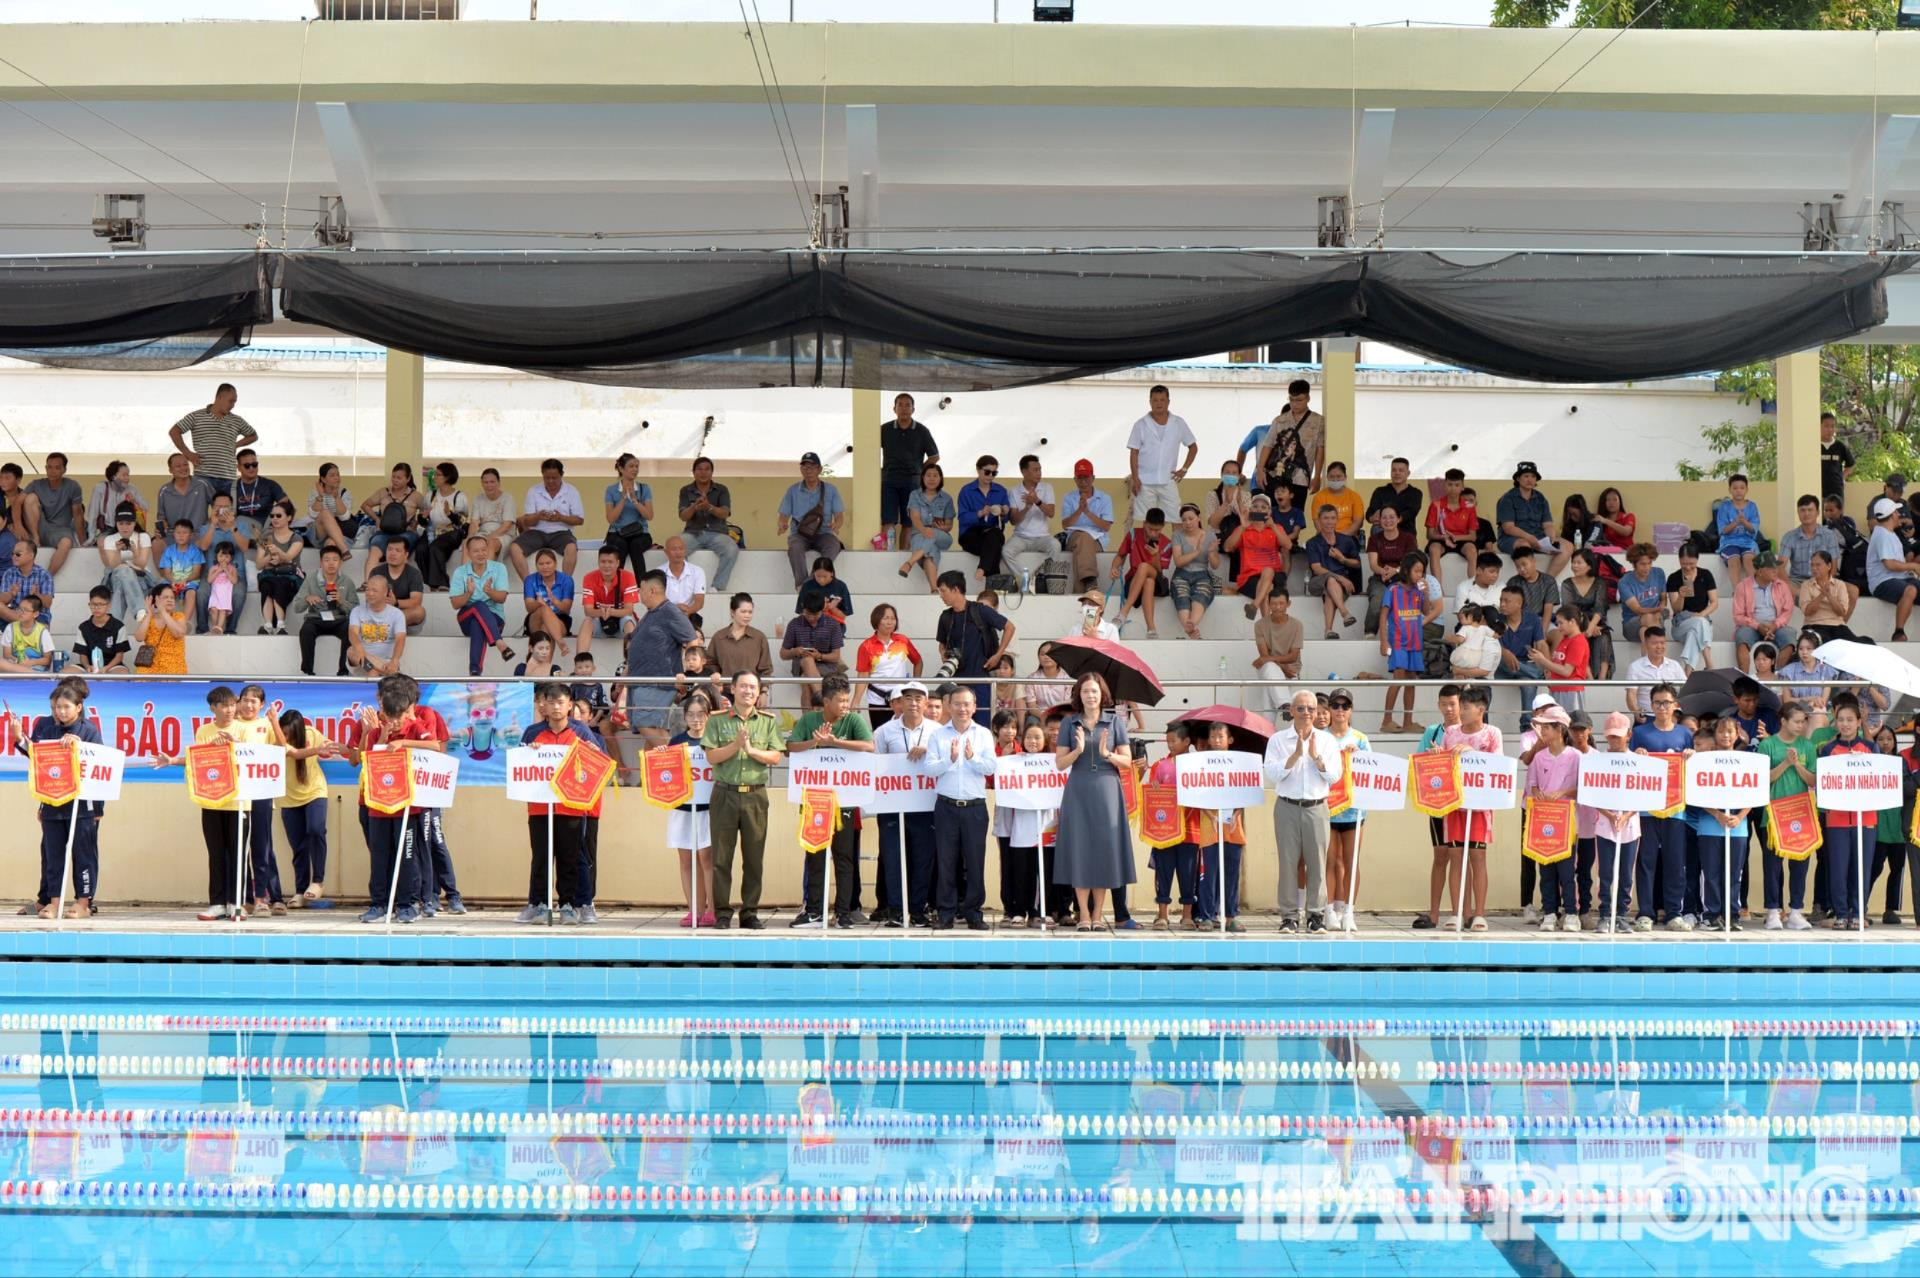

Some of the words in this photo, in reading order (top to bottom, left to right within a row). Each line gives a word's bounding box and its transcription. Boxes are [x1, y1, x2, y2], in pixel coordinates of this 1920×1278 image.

[116, 702, 180, 757] BẢO
[91, 764, 112, 781] AN
[246, 763, 280, 781] THỌ
[431, 770, 453, 790] HUẾ
[794, 766, 828, 785] VĨNH
[833, 770, 871, 787] LONG
[999, 769, 1023, 790] HẢI
[1181, 767, 1225, 789] QUẢNG
[1228, 772, 1260, 788] NINH
[1584, 771, 1621, 788] NINH
[1626, 771, 1662, 791] BÌNH
[1696, 771, 1726, 787] GIA
[1731, 773, 1759, 788] LAI
[1821, 771, 1842, 790] CÔNG
[1845, 774, 1856, 789] AN
[1858, 771, 1880, 790] NHÂN
[1882, 771, 1899, 790] DÂN
[1374, 773, 1401, 792] HOÁ
[1490, 773, 1513, 793] TRỊ
